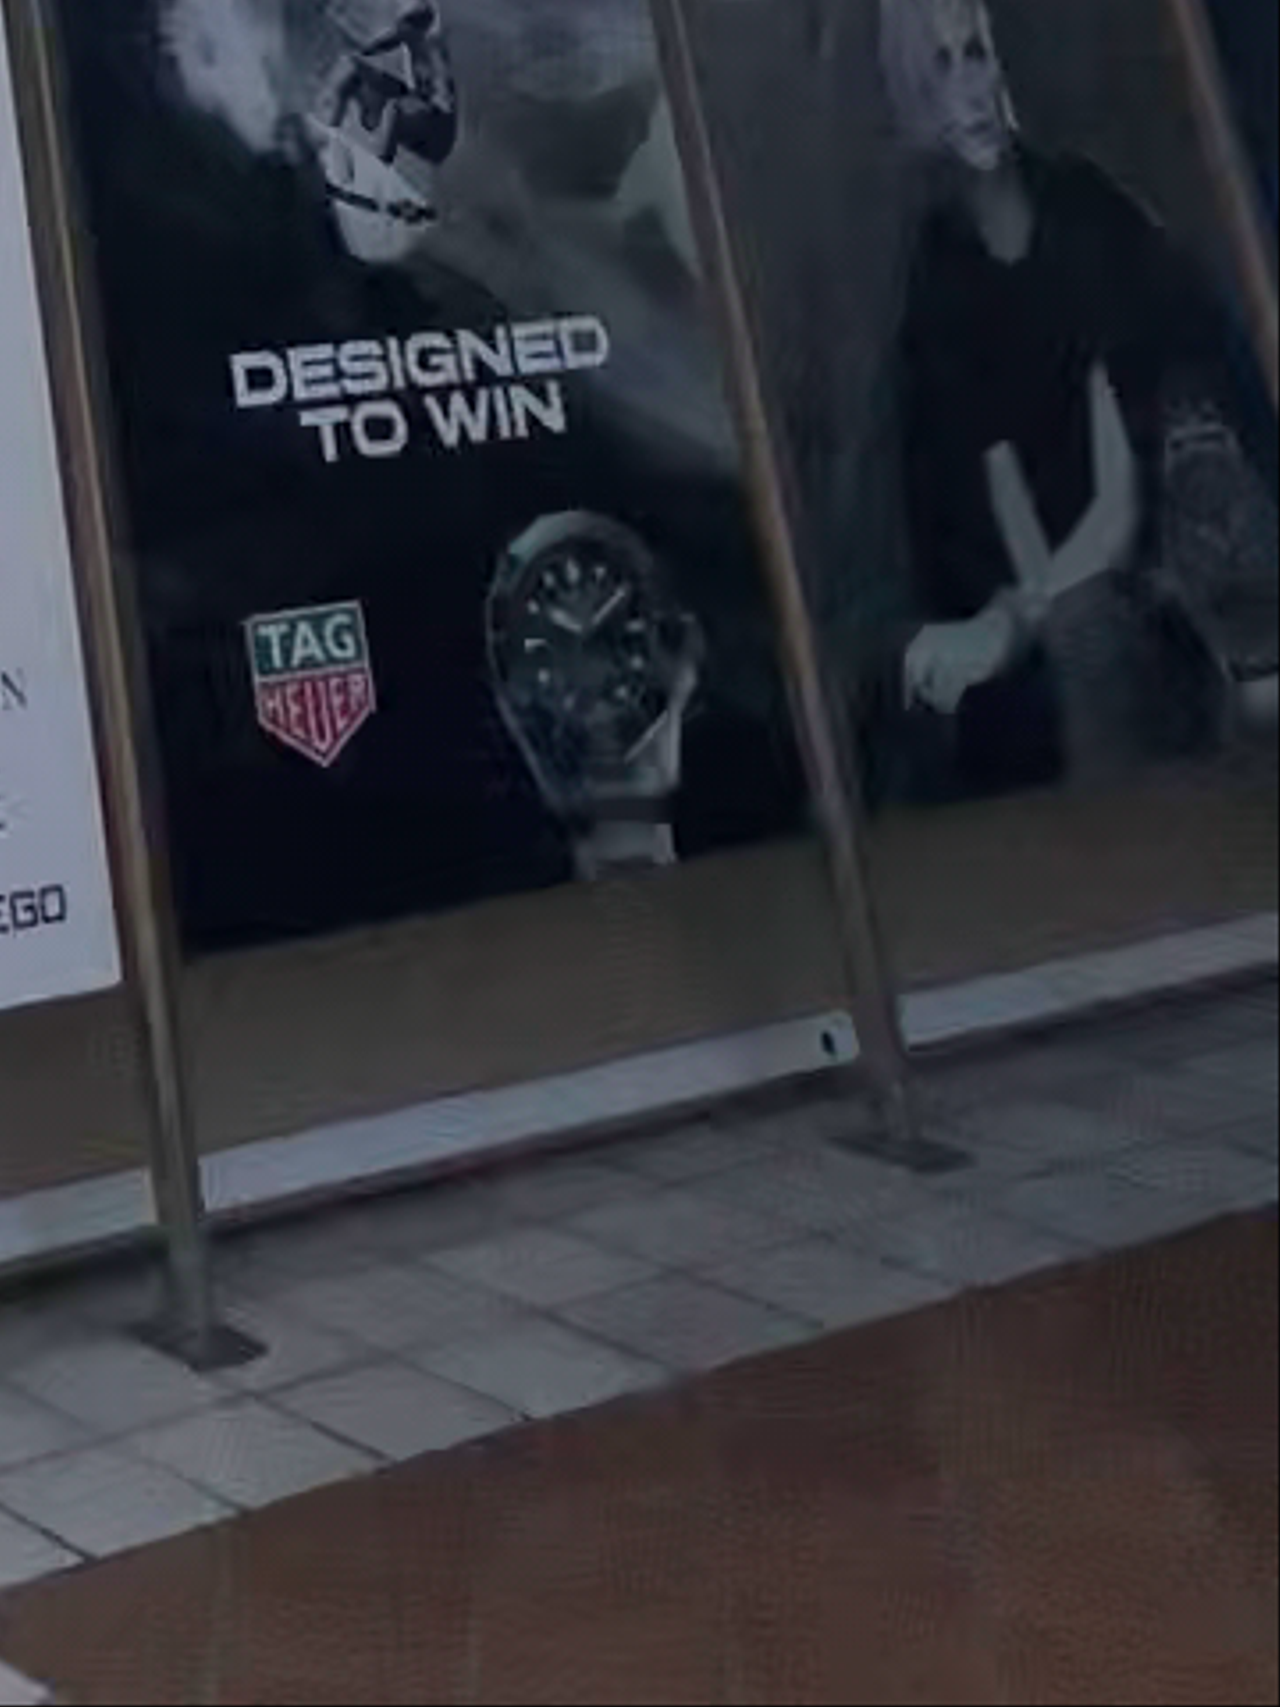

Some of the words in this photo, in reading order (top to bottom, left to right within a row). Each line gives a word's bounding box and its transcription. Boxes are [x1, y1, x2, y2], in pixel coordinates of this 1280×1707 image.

[229, 315, 611, 408] DESIGNED
[298, 403, 409, 462] TO
[425, 381, 568, 448] WIN
[258, 613, 358, 668] TAG
[260, 675, 368, 752] HEUER
